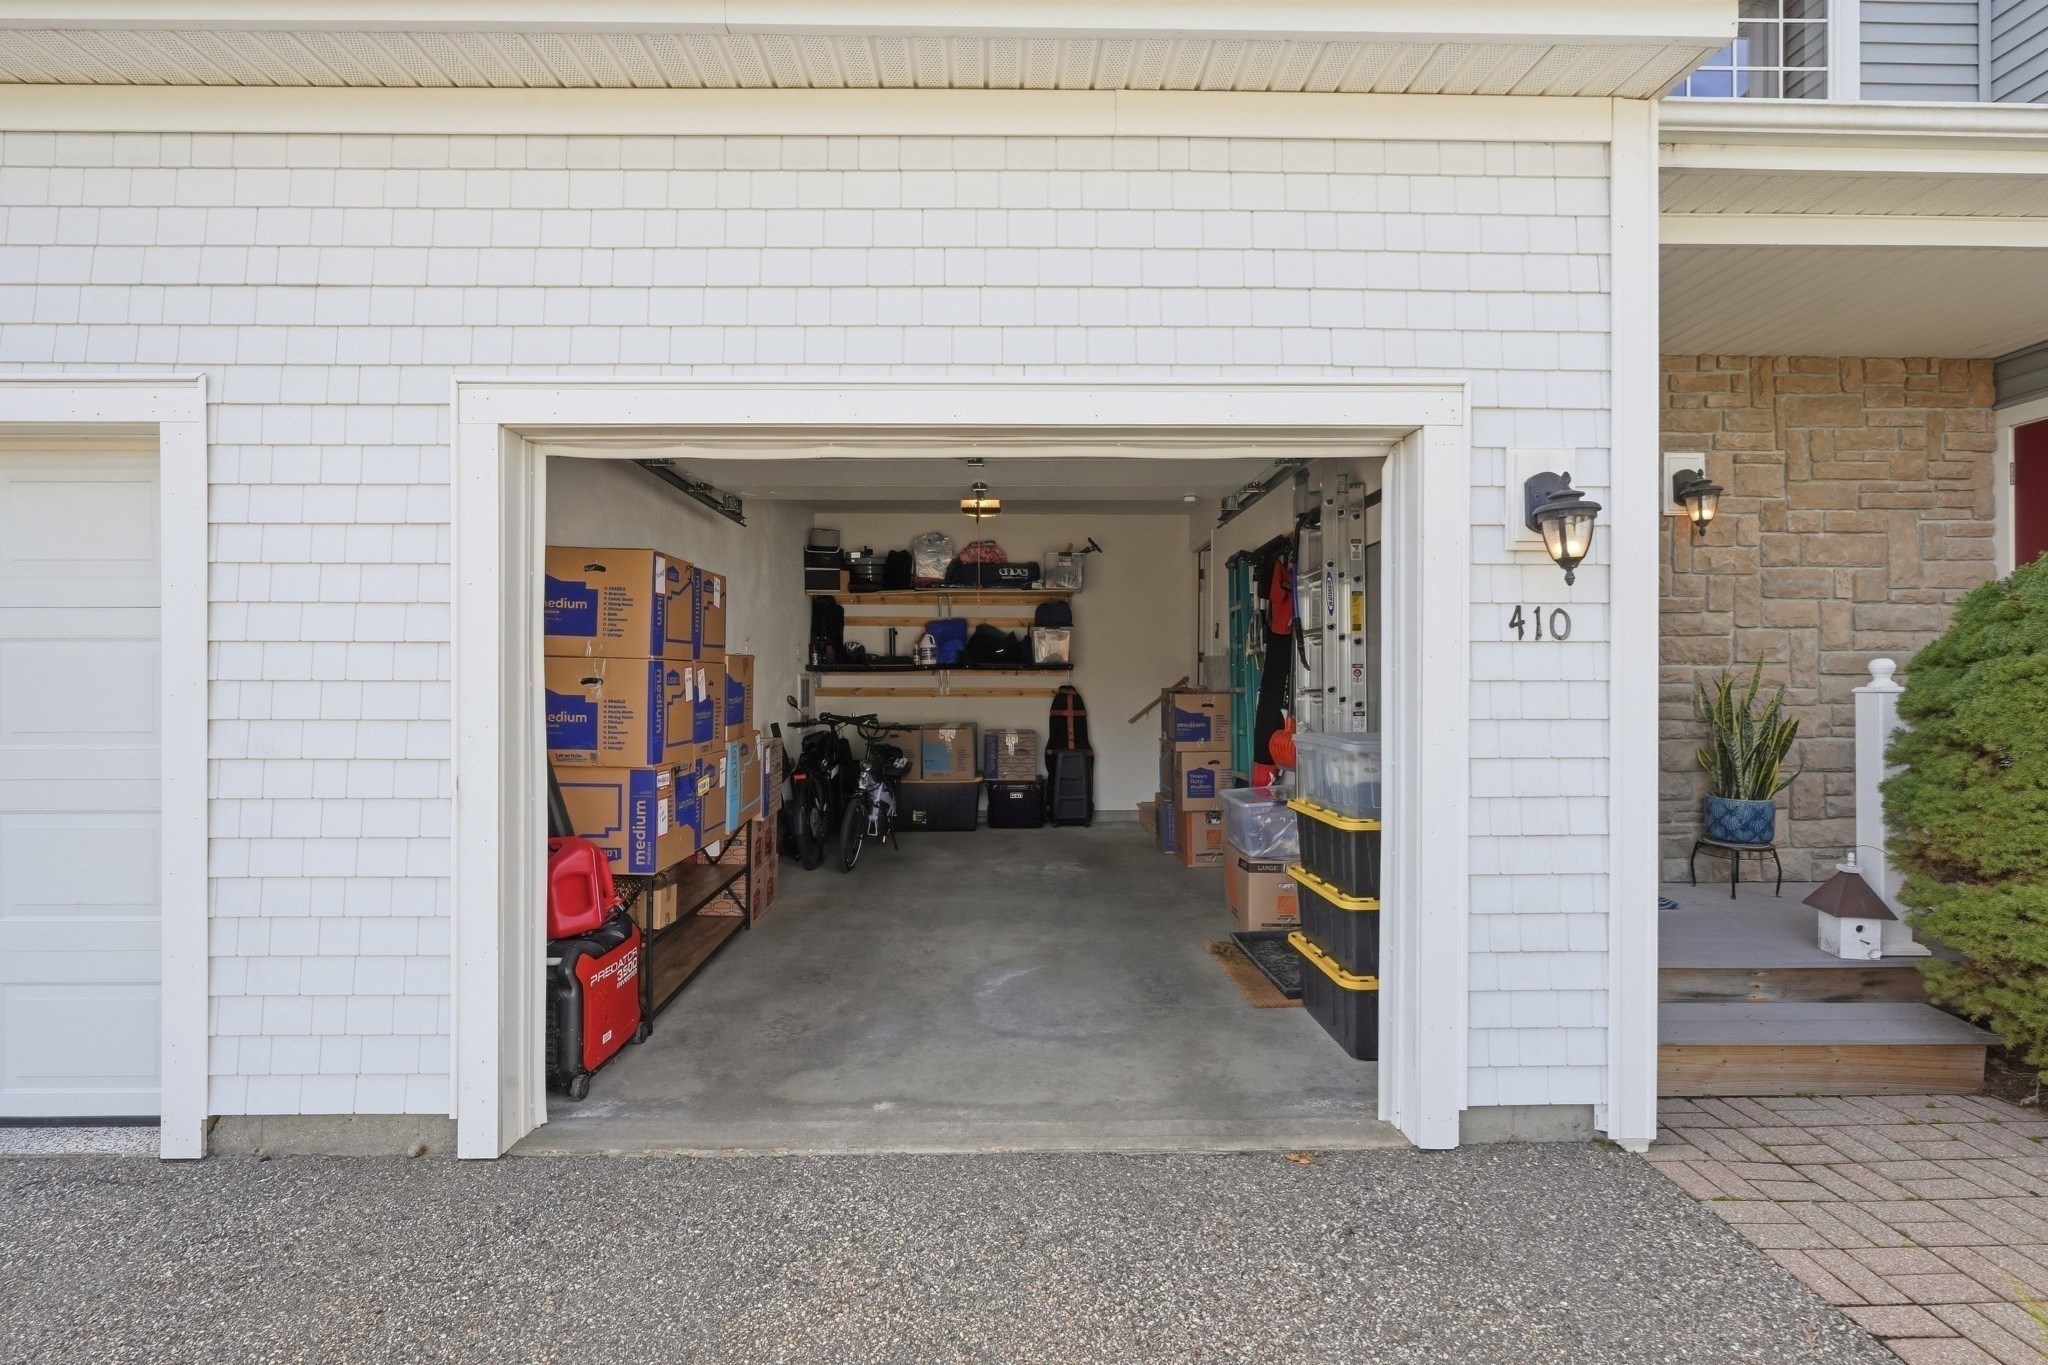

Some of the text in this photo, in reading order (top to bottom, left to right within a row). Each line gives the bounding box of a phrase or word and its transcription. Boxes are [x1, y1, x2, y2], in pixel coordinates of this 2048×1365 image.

[1508, 604, 1572, 641] 410
[547, 711, 588, 723] edium
[656, 669, 664, 734] medium
[632, 800, 647, 865] medium
[590, 946, 638, 987] PREDATOR
[616, 957, 638, 982] 3500
